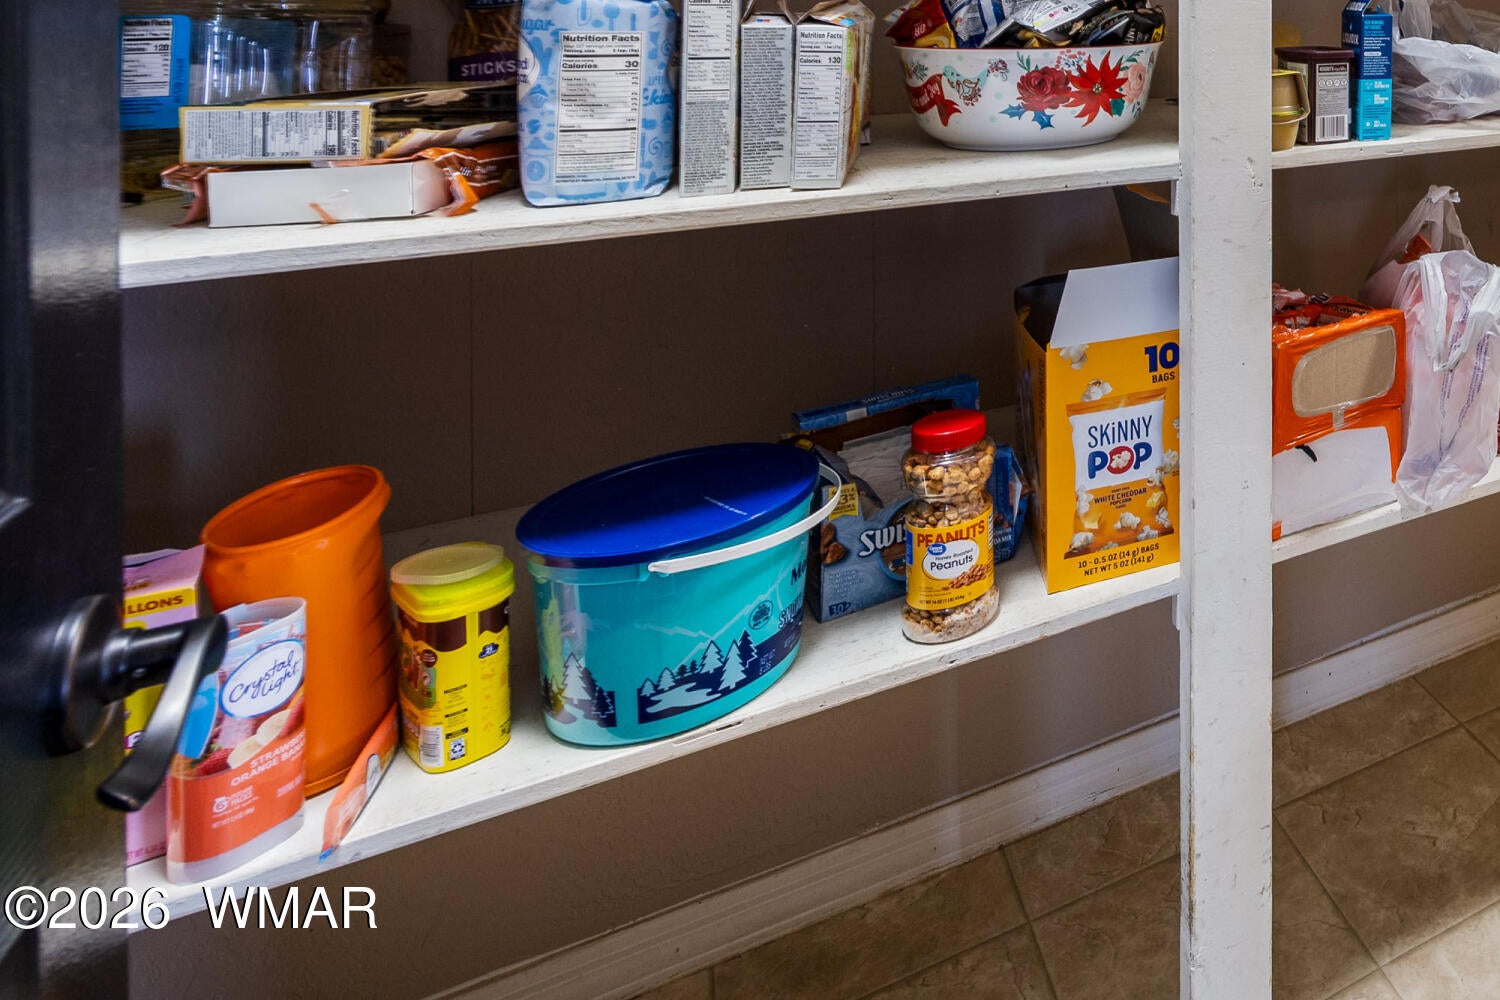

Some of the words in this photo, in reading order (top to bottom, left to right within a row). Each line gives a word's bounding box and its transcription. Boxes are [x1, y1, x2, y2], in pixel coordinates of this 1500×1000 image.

[611, 35, 640, 43] Facts
[800, 31, 825, 39] Nutrition
[826, 31, 843, 39] Facts
[461, 59, 516, 77] STICKS
[624, 60, 639, 68] 30
[799, 57, 821, 65] Calories
[828, 56, 841, 64] 130
[1144, 342, 1180, 373] 10
[1151, 372, 1176, 383] BAGS
[1087, 441, 1152, 479] POP
[1094, 494, 1115, 504] WHITE
[1115, 488, 1147, 500] CHEDDAR
[917, 520, 985, 548] PEANUTS
[930, 554, 974, 571] Peanuts
[1078, 560, 1087, 569] 10
[1107, 553, 1117, 562] OZ
[1140, 543, 1160, 555] BAGS
[1084, 567, 1098, 576] NET
[1099, 564, 1113, 573] WT
[1120, 560, 1130, 569] OZ
[228, 650, 295, 703] Crystal
